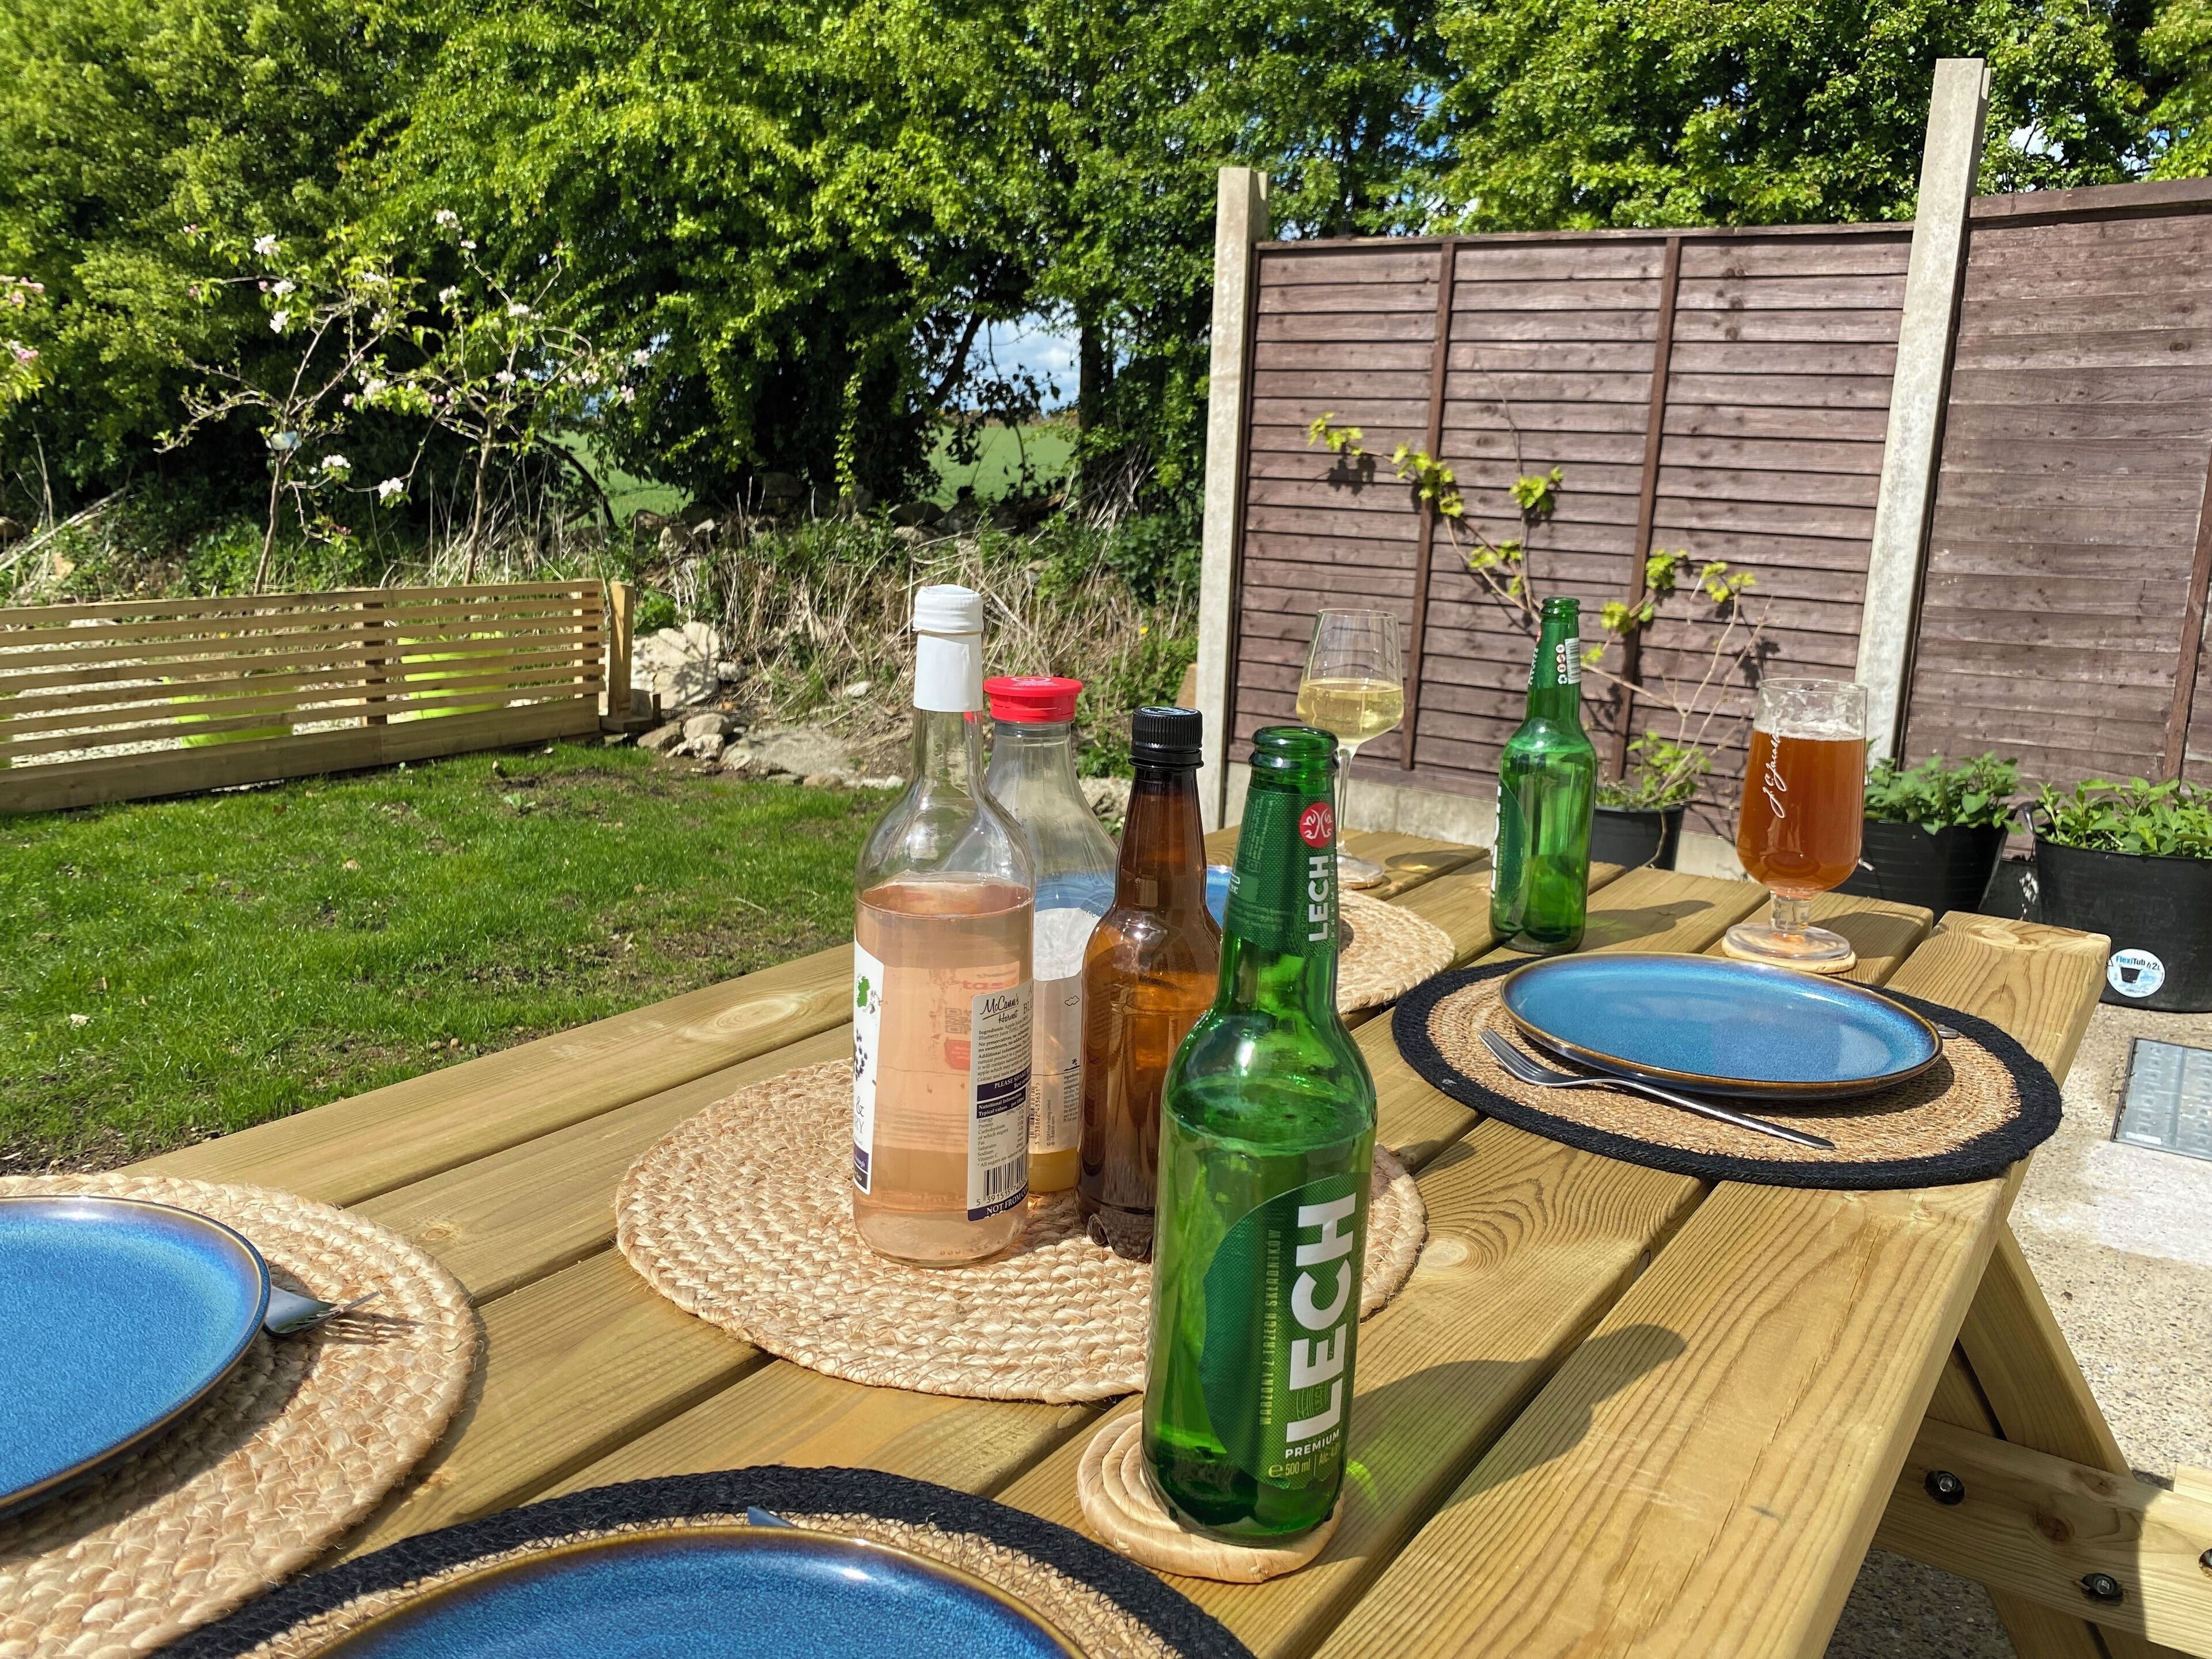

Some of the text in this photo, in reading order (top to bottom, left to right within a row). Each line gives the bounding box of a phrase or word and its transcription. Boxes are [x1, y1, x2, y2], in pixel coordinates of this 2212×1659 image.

[1308, 855, 1329, 942] LECH
[979, 993, 1019, 1015] McCann's
[994, 1077, 1014, 1089] PLEASE
[986, 1202, 1004, 1215] NOT
[1005, 1194, 1021, 1209] FROM
[1286, 1192, 1356, 1443] LECH
[1285, 1429, 1340, 1459] PREMIUM
[1285, 1461, 1300, 1476] 500
[1301, 1457, 1310, 1473] ml
